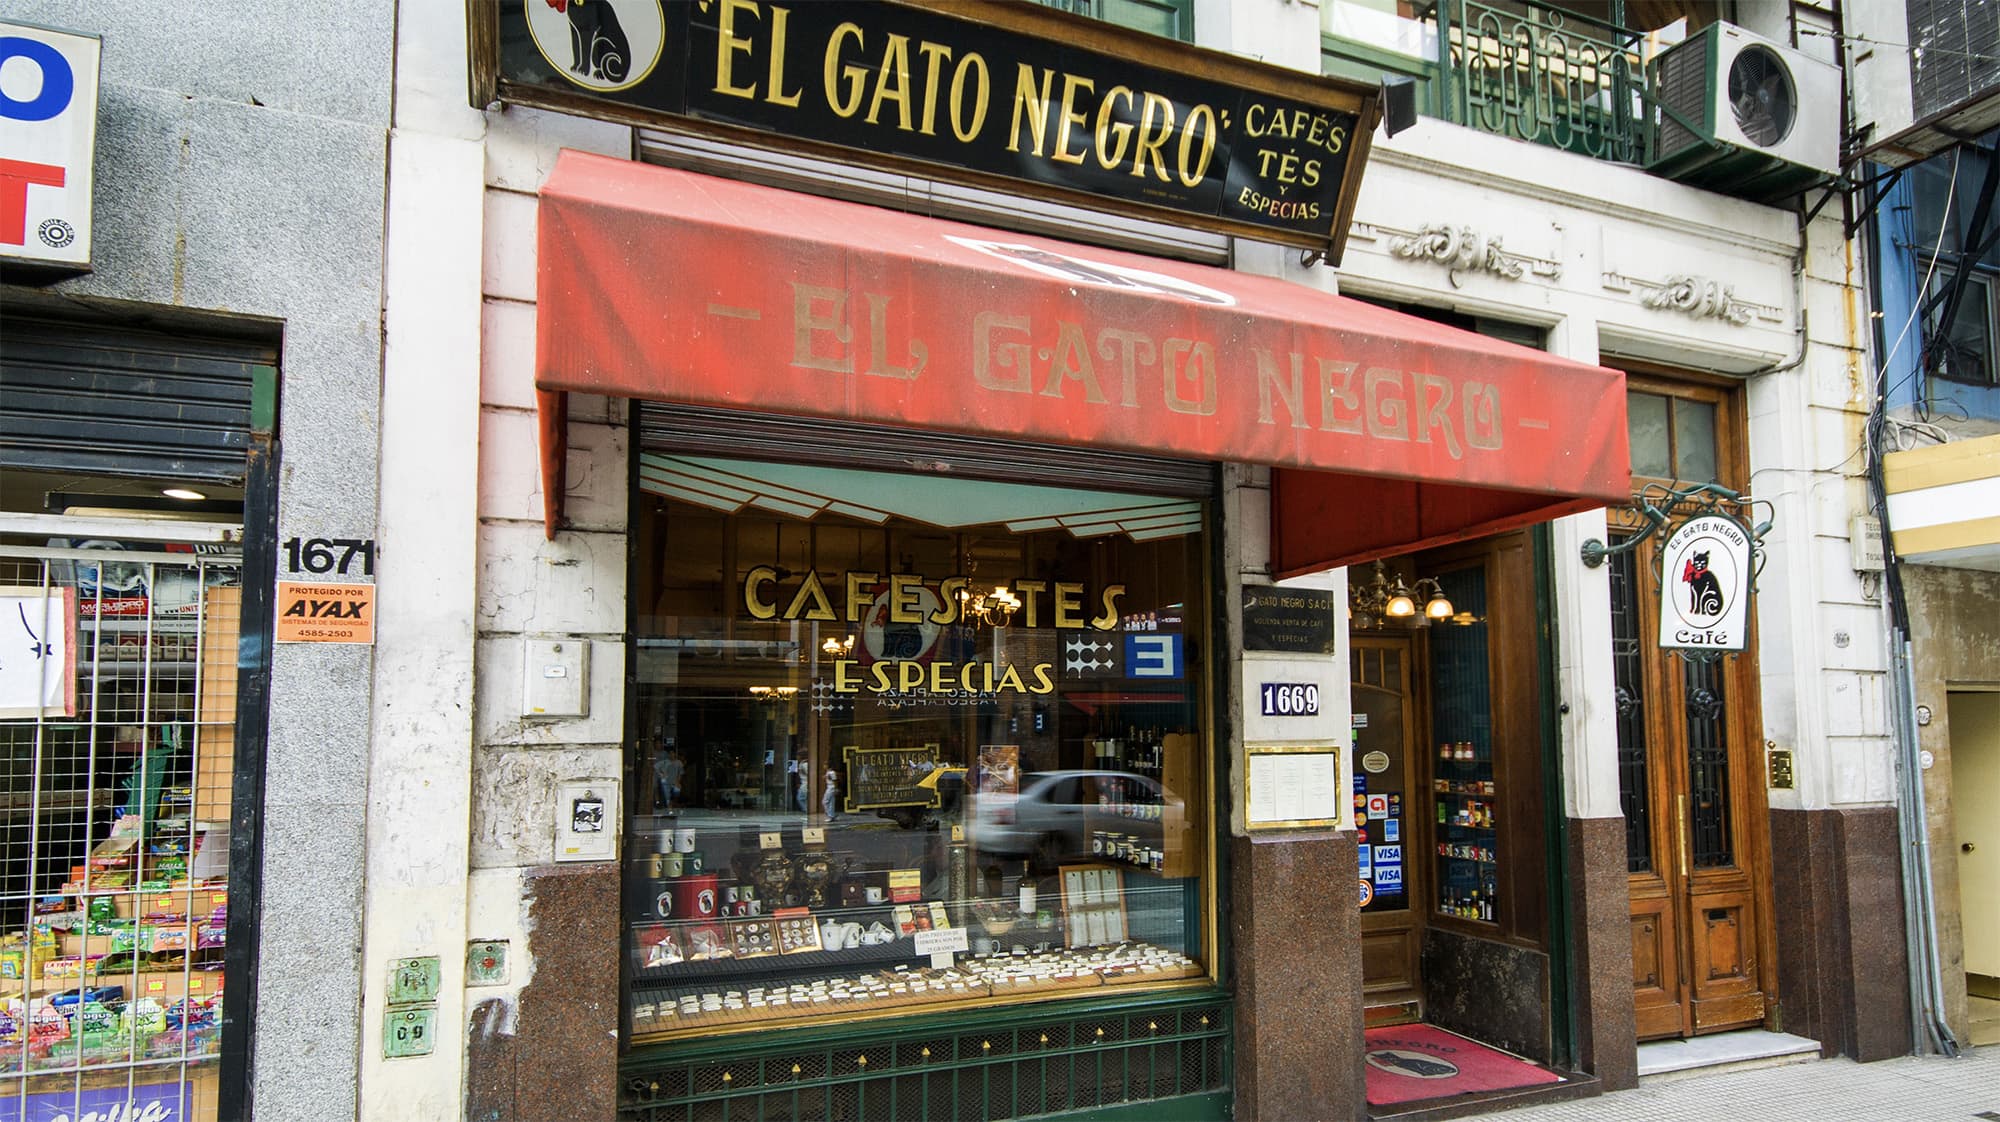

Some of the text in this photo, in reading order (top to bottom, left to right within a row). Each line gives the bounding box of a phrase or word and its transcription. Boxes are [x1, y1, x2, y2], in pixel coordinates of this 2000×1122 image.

[823, 21, 990, 143] GATO
[1245, 103, 1346, 154] CAFÉS
[1257, 148, 1321, 187] TÉS
[1238, 186, 1320, 220] ESPECIAS
[1279, 185, 1288, 196] Y
[789, 280, 1503, 460] EL GATO NEGRO
[1670, 522, 1744, 550] EL GATO NEGRO
[283, 537, 374, 576] 1671
[289, 587, 342, 596] PROTEGIDO
[744, 565, 1127, 631] CAFES TES
[1259, 597, 1278, 607] GATO
[1281, 597, 1305, 609] NEGRO
[283, 599, 368, 619] AYAX
[298, 629, 353, 638] 4585-2503
[1675, 629, 1728, 645] Café
[834, 659, 1055, 694] ESPECIAS
[1263, 685, 1319, 714] 1669
[1377, 848, 1400, 859] VISA
[1378, 870, 1401, 881] VISA
